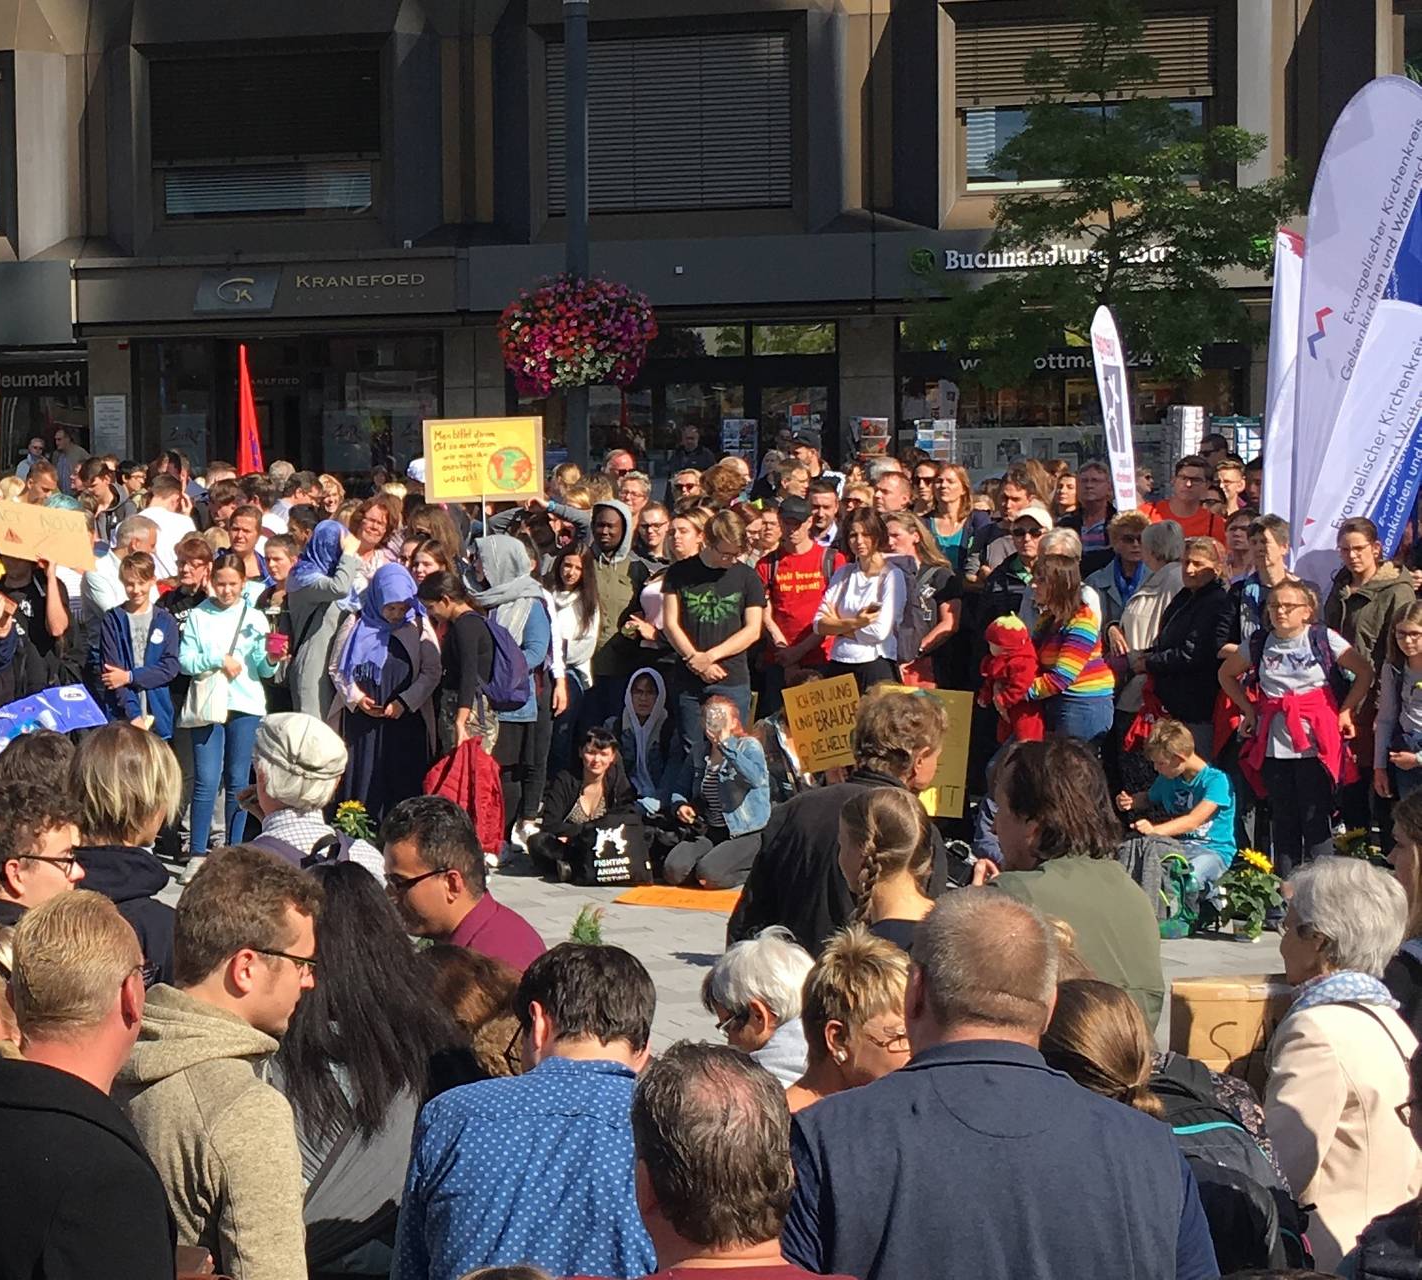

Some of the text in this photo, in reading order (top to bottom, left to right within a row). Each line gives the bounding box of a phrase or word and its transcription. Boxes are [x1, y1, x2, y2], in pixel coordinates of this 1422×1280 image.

[1382, 236, 1398, 268] und
[1343, 217, 1387, 325] Evangelischer
[796, 683, 853, 709] ICH BIN JUNG
[794, 715, 814, 731] UND
[811, 734, 850, 756] DIE WELT
[597, 866, 629, 876] ANIMAL
